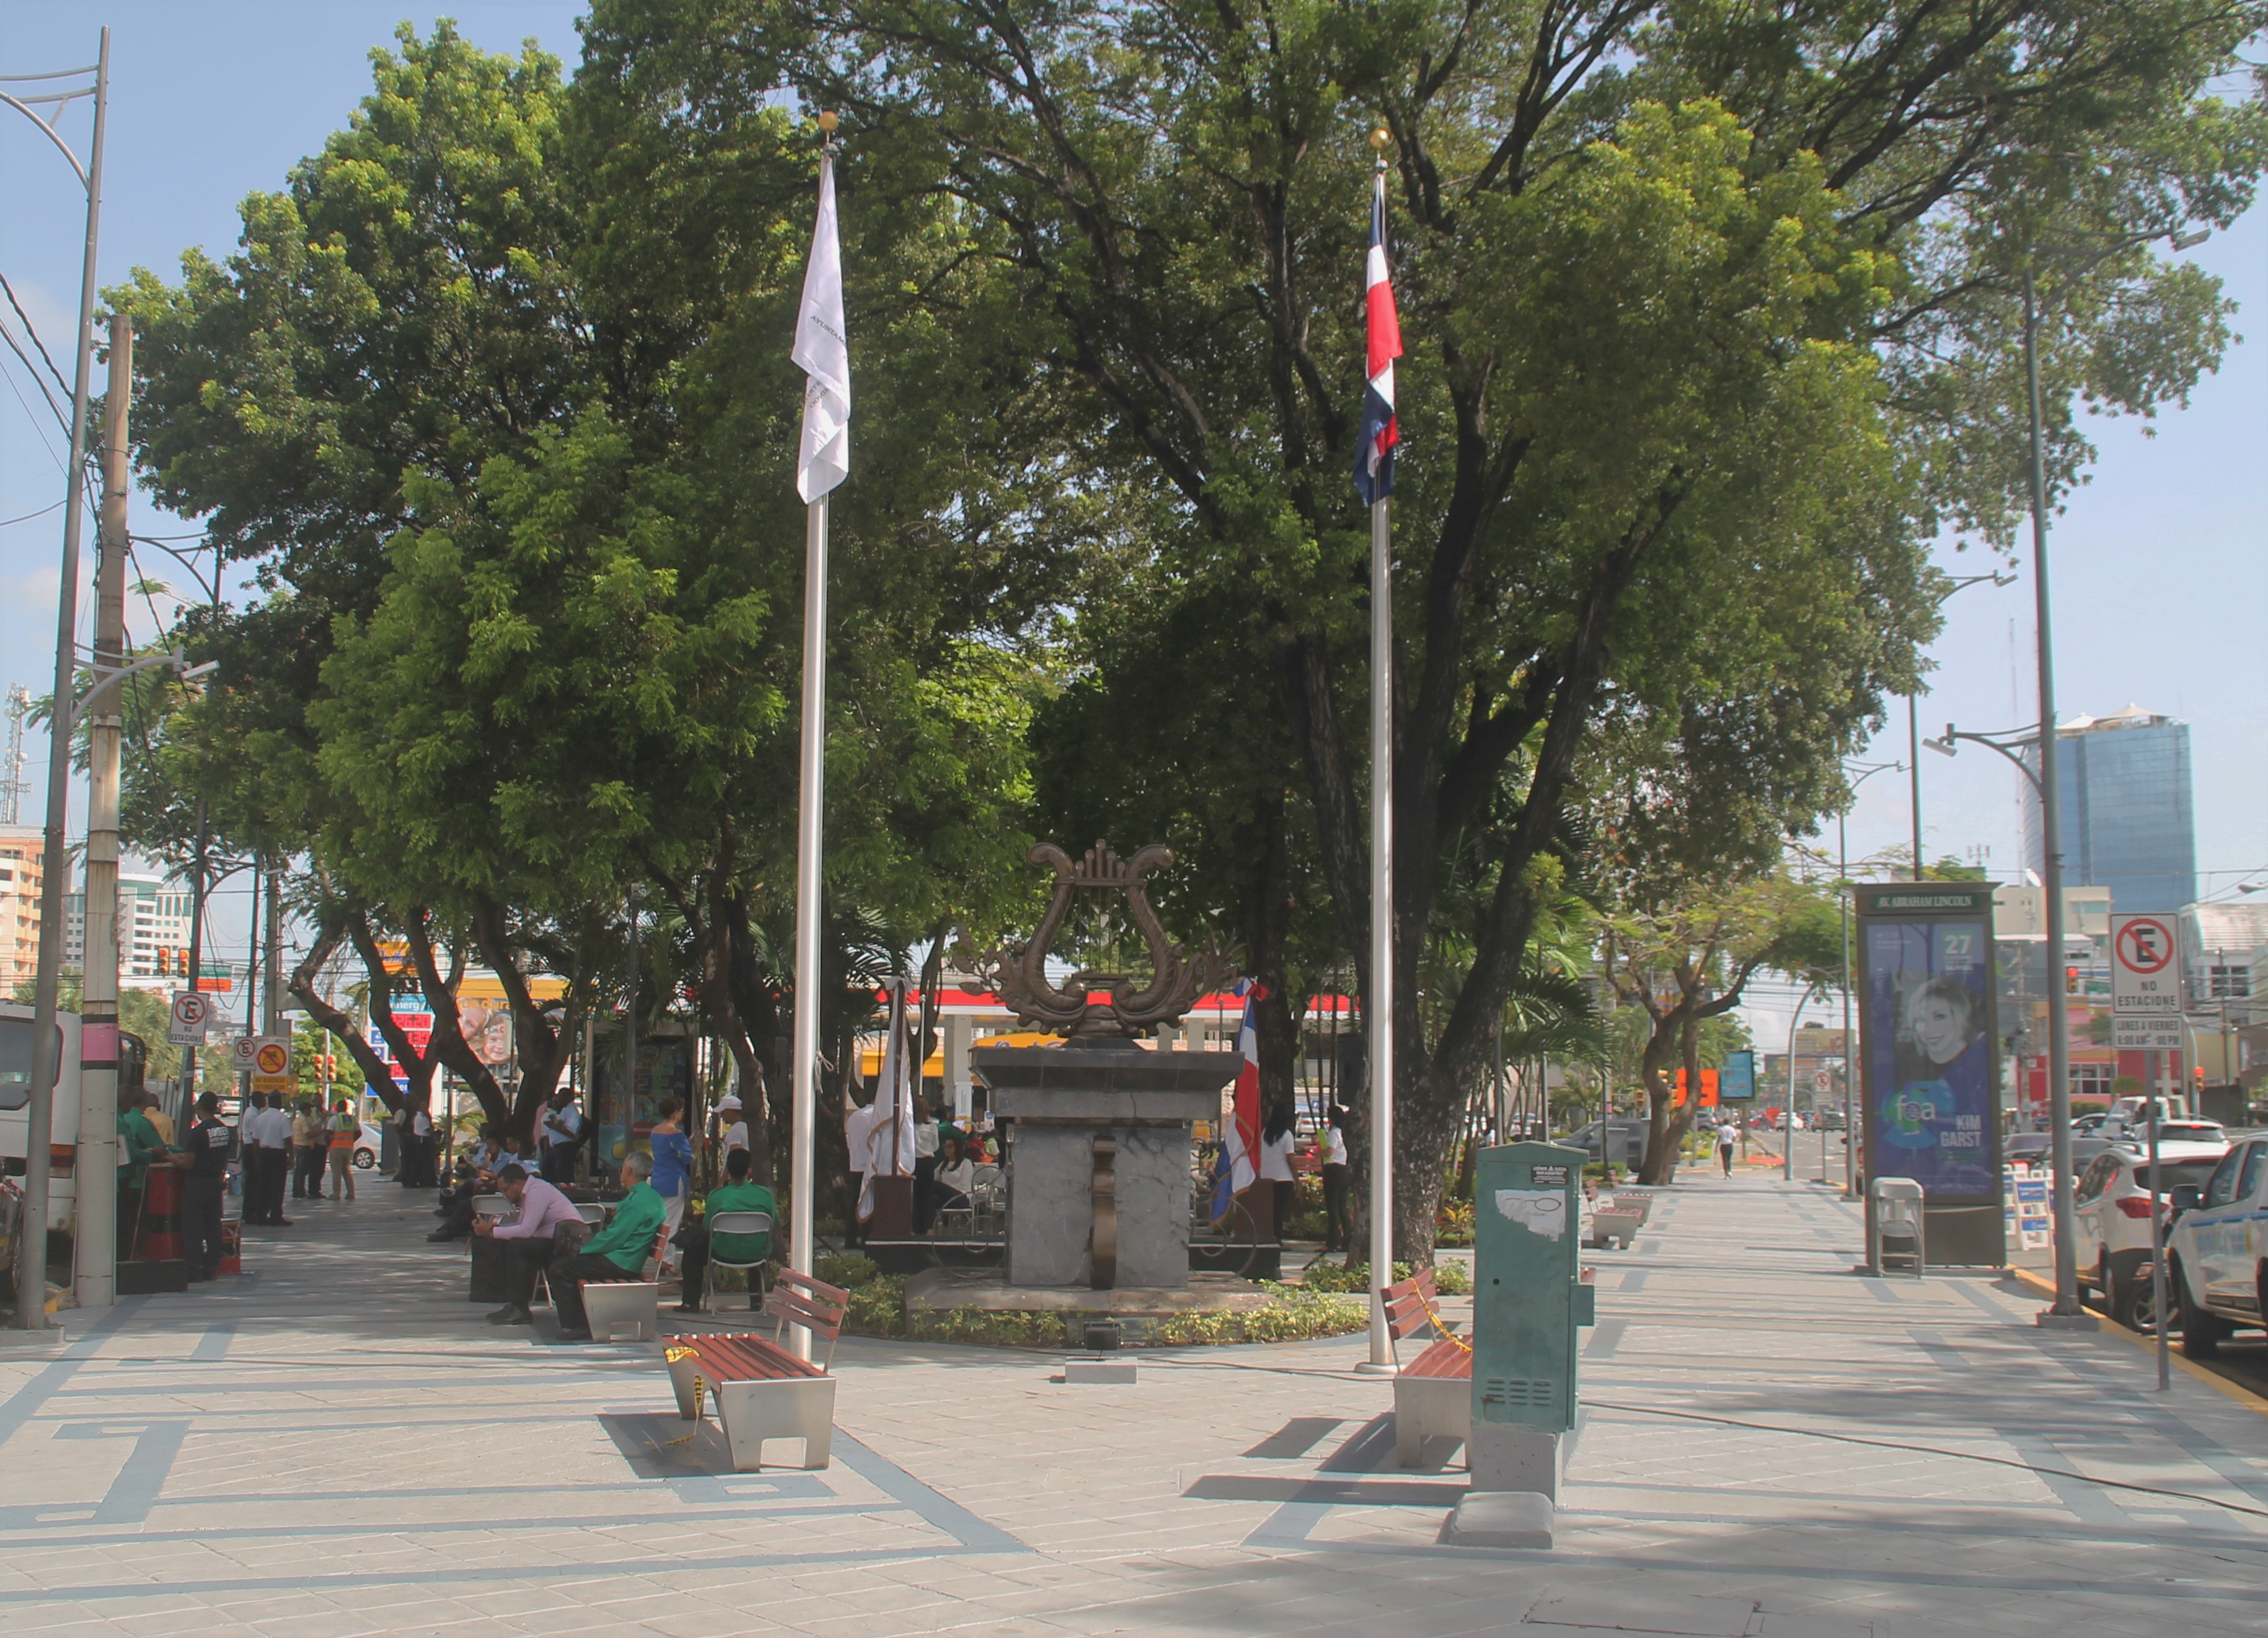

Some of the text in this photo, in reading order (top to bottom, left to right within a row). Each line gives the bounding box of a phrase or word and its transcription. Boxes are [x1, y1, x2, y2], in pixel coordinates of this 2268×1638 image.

[1892, 896, 1932, 907] ABRAHAM
[1934, 895, 1972, 906] LINCOLN
[1944, 935, 1972, 954] 27
[2141, 981, 2157, 991] NO
[2118, 996, 2176, 1006] ESTACIONE
[2117, 1020, 2179, 1030] LUNES A VIERNES
[170, 1034, 203, 1042] ESTACIONE
[1957, 1115, 1981, 1130] KIM
[1940, 1131, 1982, 1147] GARST
